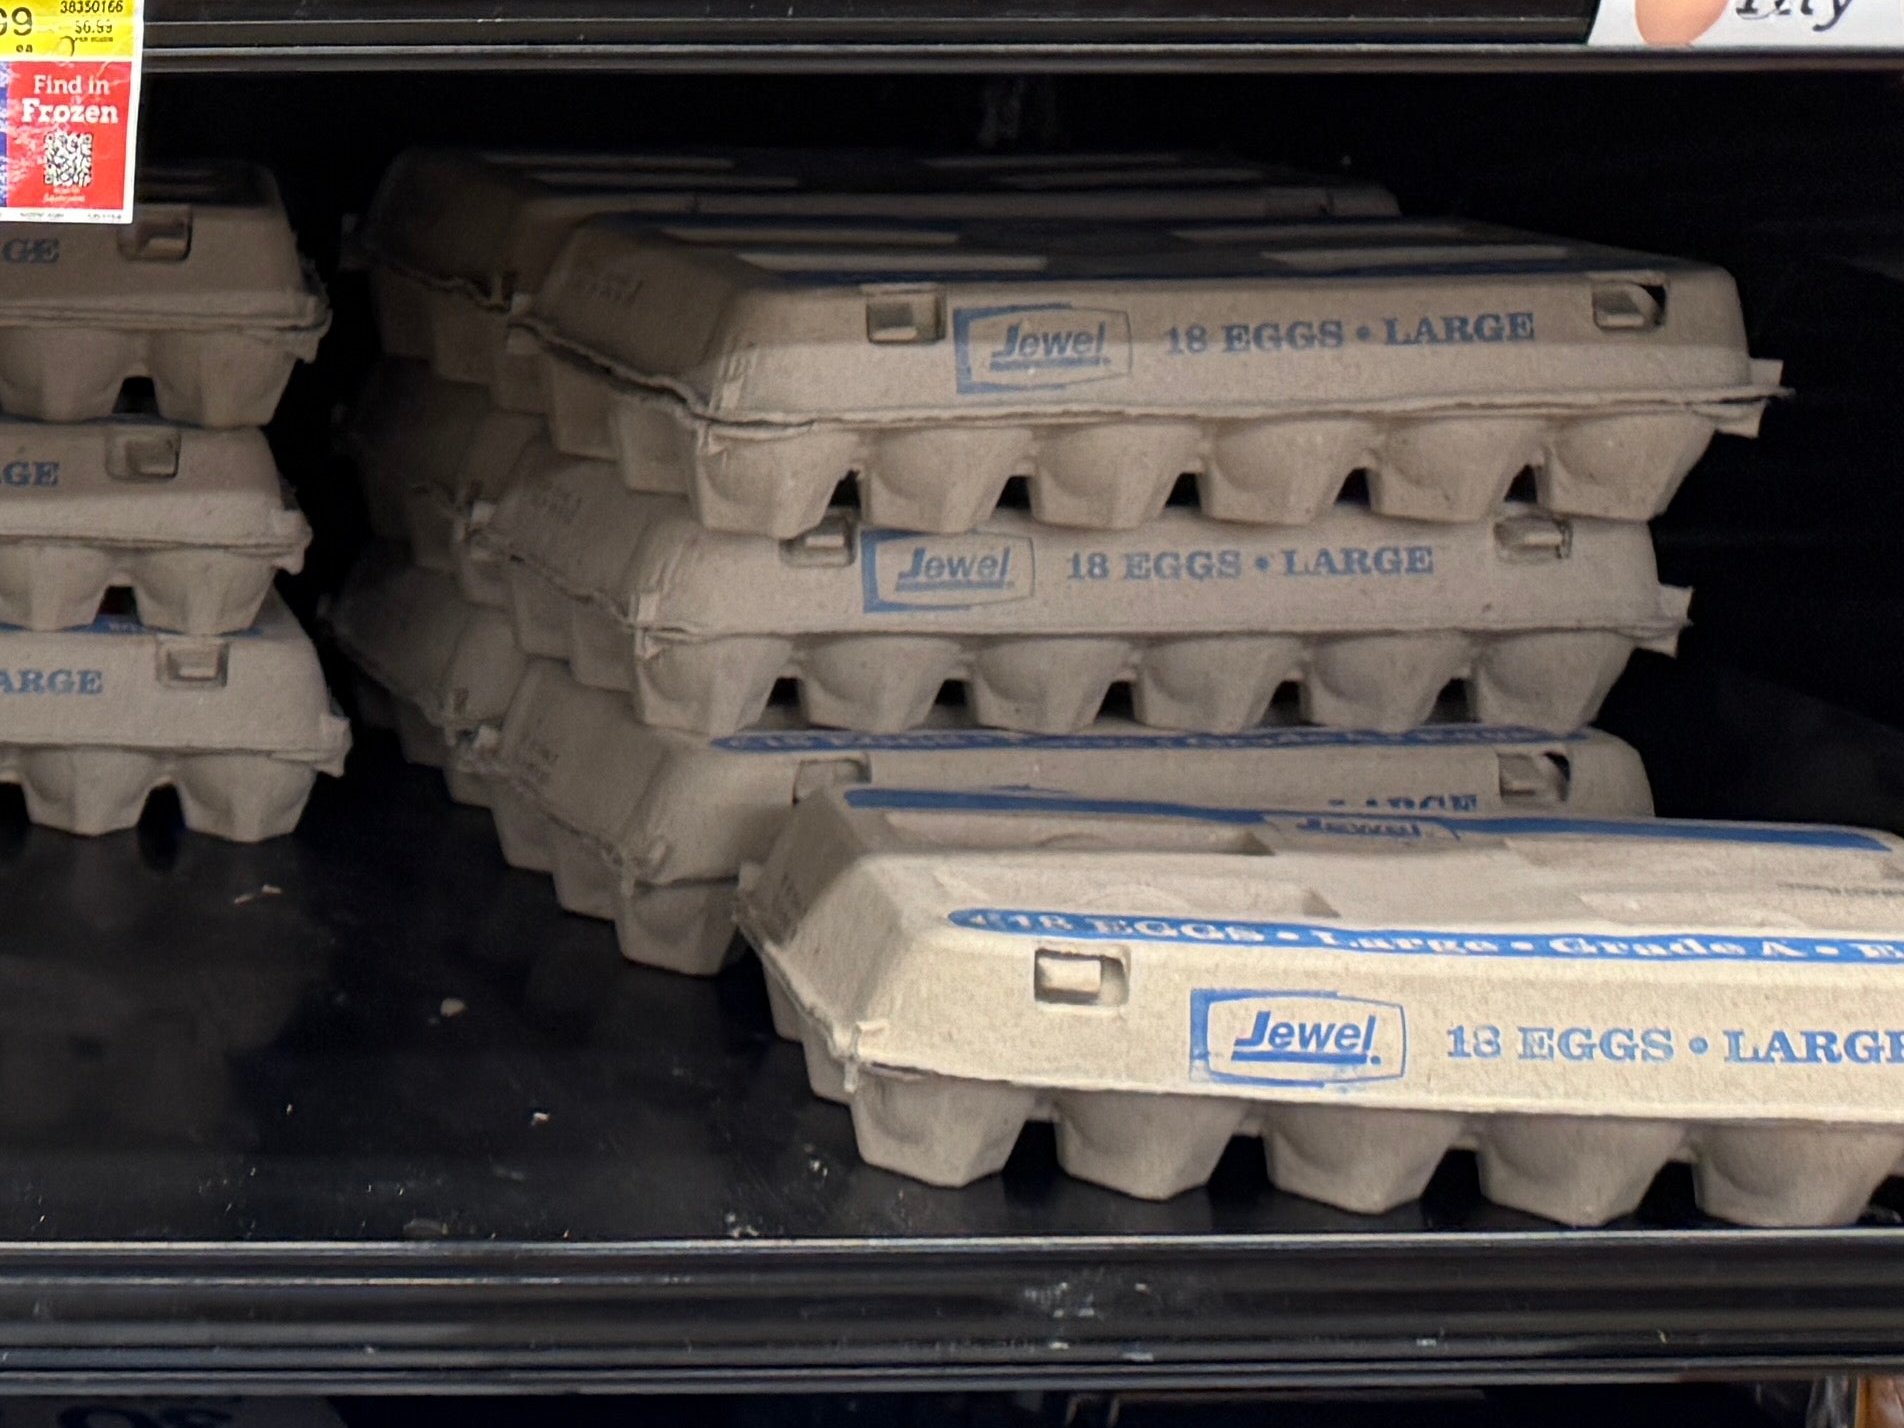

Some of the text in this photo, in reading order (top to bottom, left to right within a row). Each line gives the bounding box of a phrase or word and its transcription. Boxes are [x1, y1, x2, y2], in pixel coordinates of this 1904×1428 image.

[34, 75, 110, 95] Find in
[21, 98, 119, 123] Frozen
[994, 313, 1536, 357] Jewel 18 EGGS LARGE
[1233, 1010, 1674, 1063] Jewel 18 EGGS
